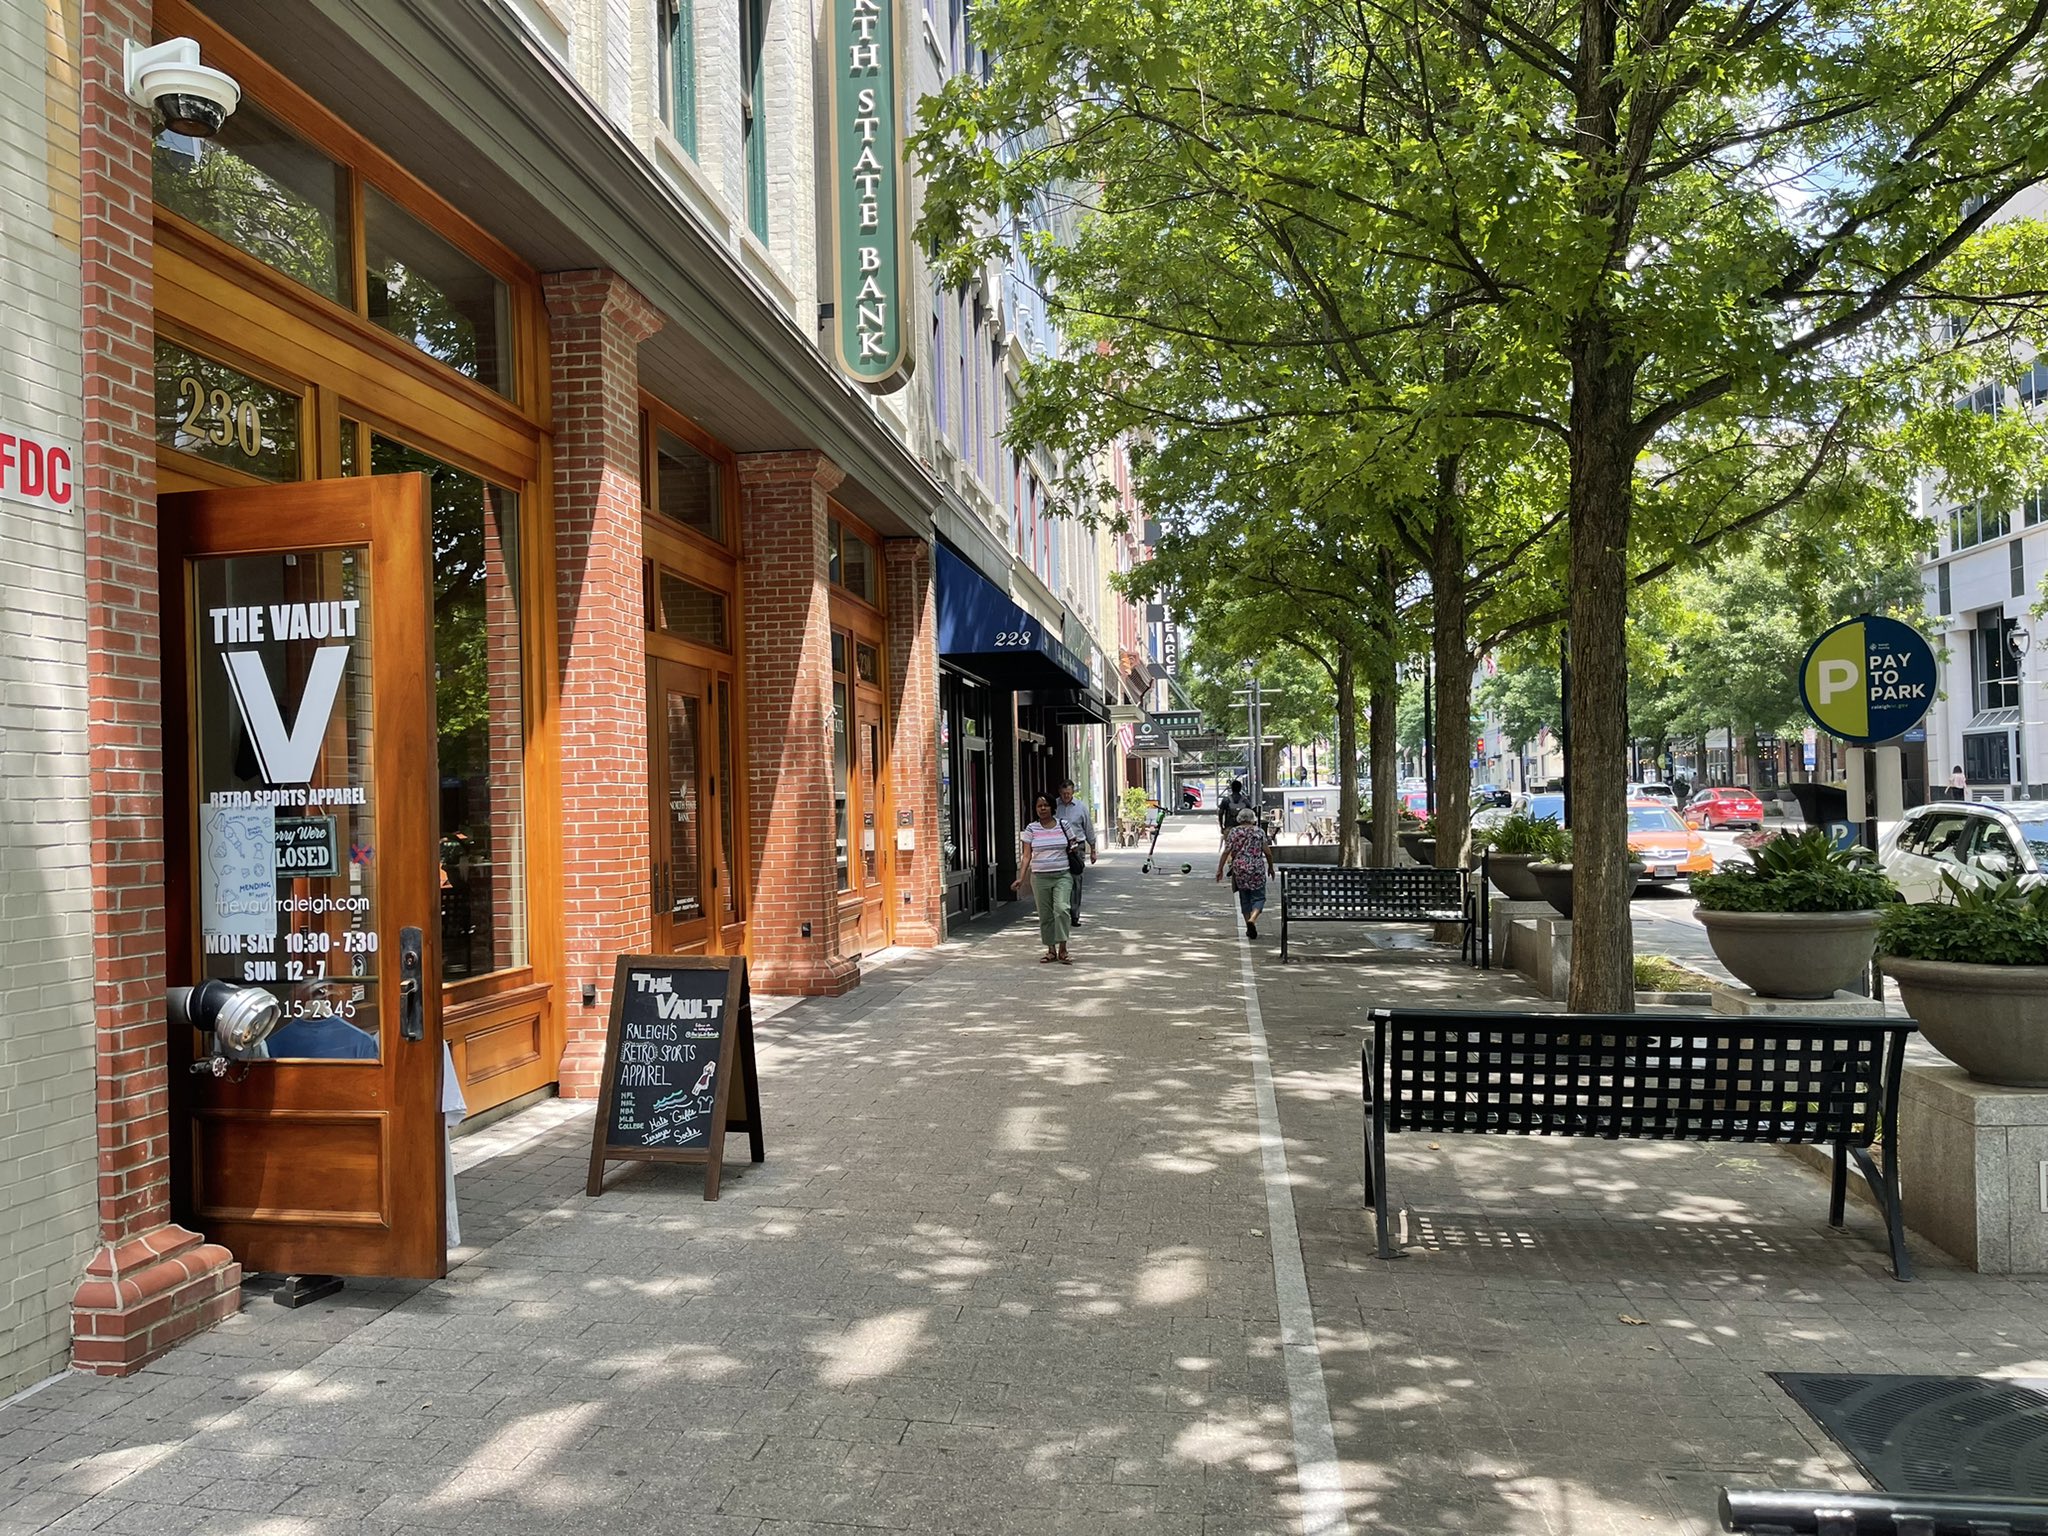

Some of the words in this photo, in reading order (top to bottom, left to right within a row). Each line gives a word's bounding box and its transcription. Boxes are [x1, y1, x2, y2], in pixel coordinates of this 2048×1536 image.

[853, 88, 883, 228] STATE
[856, 248, 889, 357] BANK
[180, 377, 262, 458] 230
[0, 432, 72, 504] FDC
[209, 606, 265, 644] THE
[269, 600, 360, 641] VAULT
[994, 631, 1031, 647] 228
[1870, 653, 1911, 670] PAY
[1818, 659, 1859, 705] P
[1870, 670, 1899, 686] TO
[1871, 684, 1926, 701] PARK
[221, 646, 350, 784] V
[210, 790, 251, 808] RETRO
[254, 789, 306, 807] SPORTS
[309, 787, 367, 805] APPAREL
[275, 830, 296, 846] orry
[276, 846, 329, 867] LOSED
[284, 932, 329, 953] 10:30
[342, 932, 378, 953] 7:30
[244, 961, 277, 981] SUN
[284, 961, 304, 981] 12
[316, 960, 326, 981] 7
[632, 973, 672, 993] THE
[283, 1000, 356, 1018] 15-2345
[656, 992, 723, 1020] VAULT
[622, 1042, 656, 1062] RETRO
[659, 1044, 697, 1063] SPORTS
[620, 1064, 673, 1086] APPAREL
